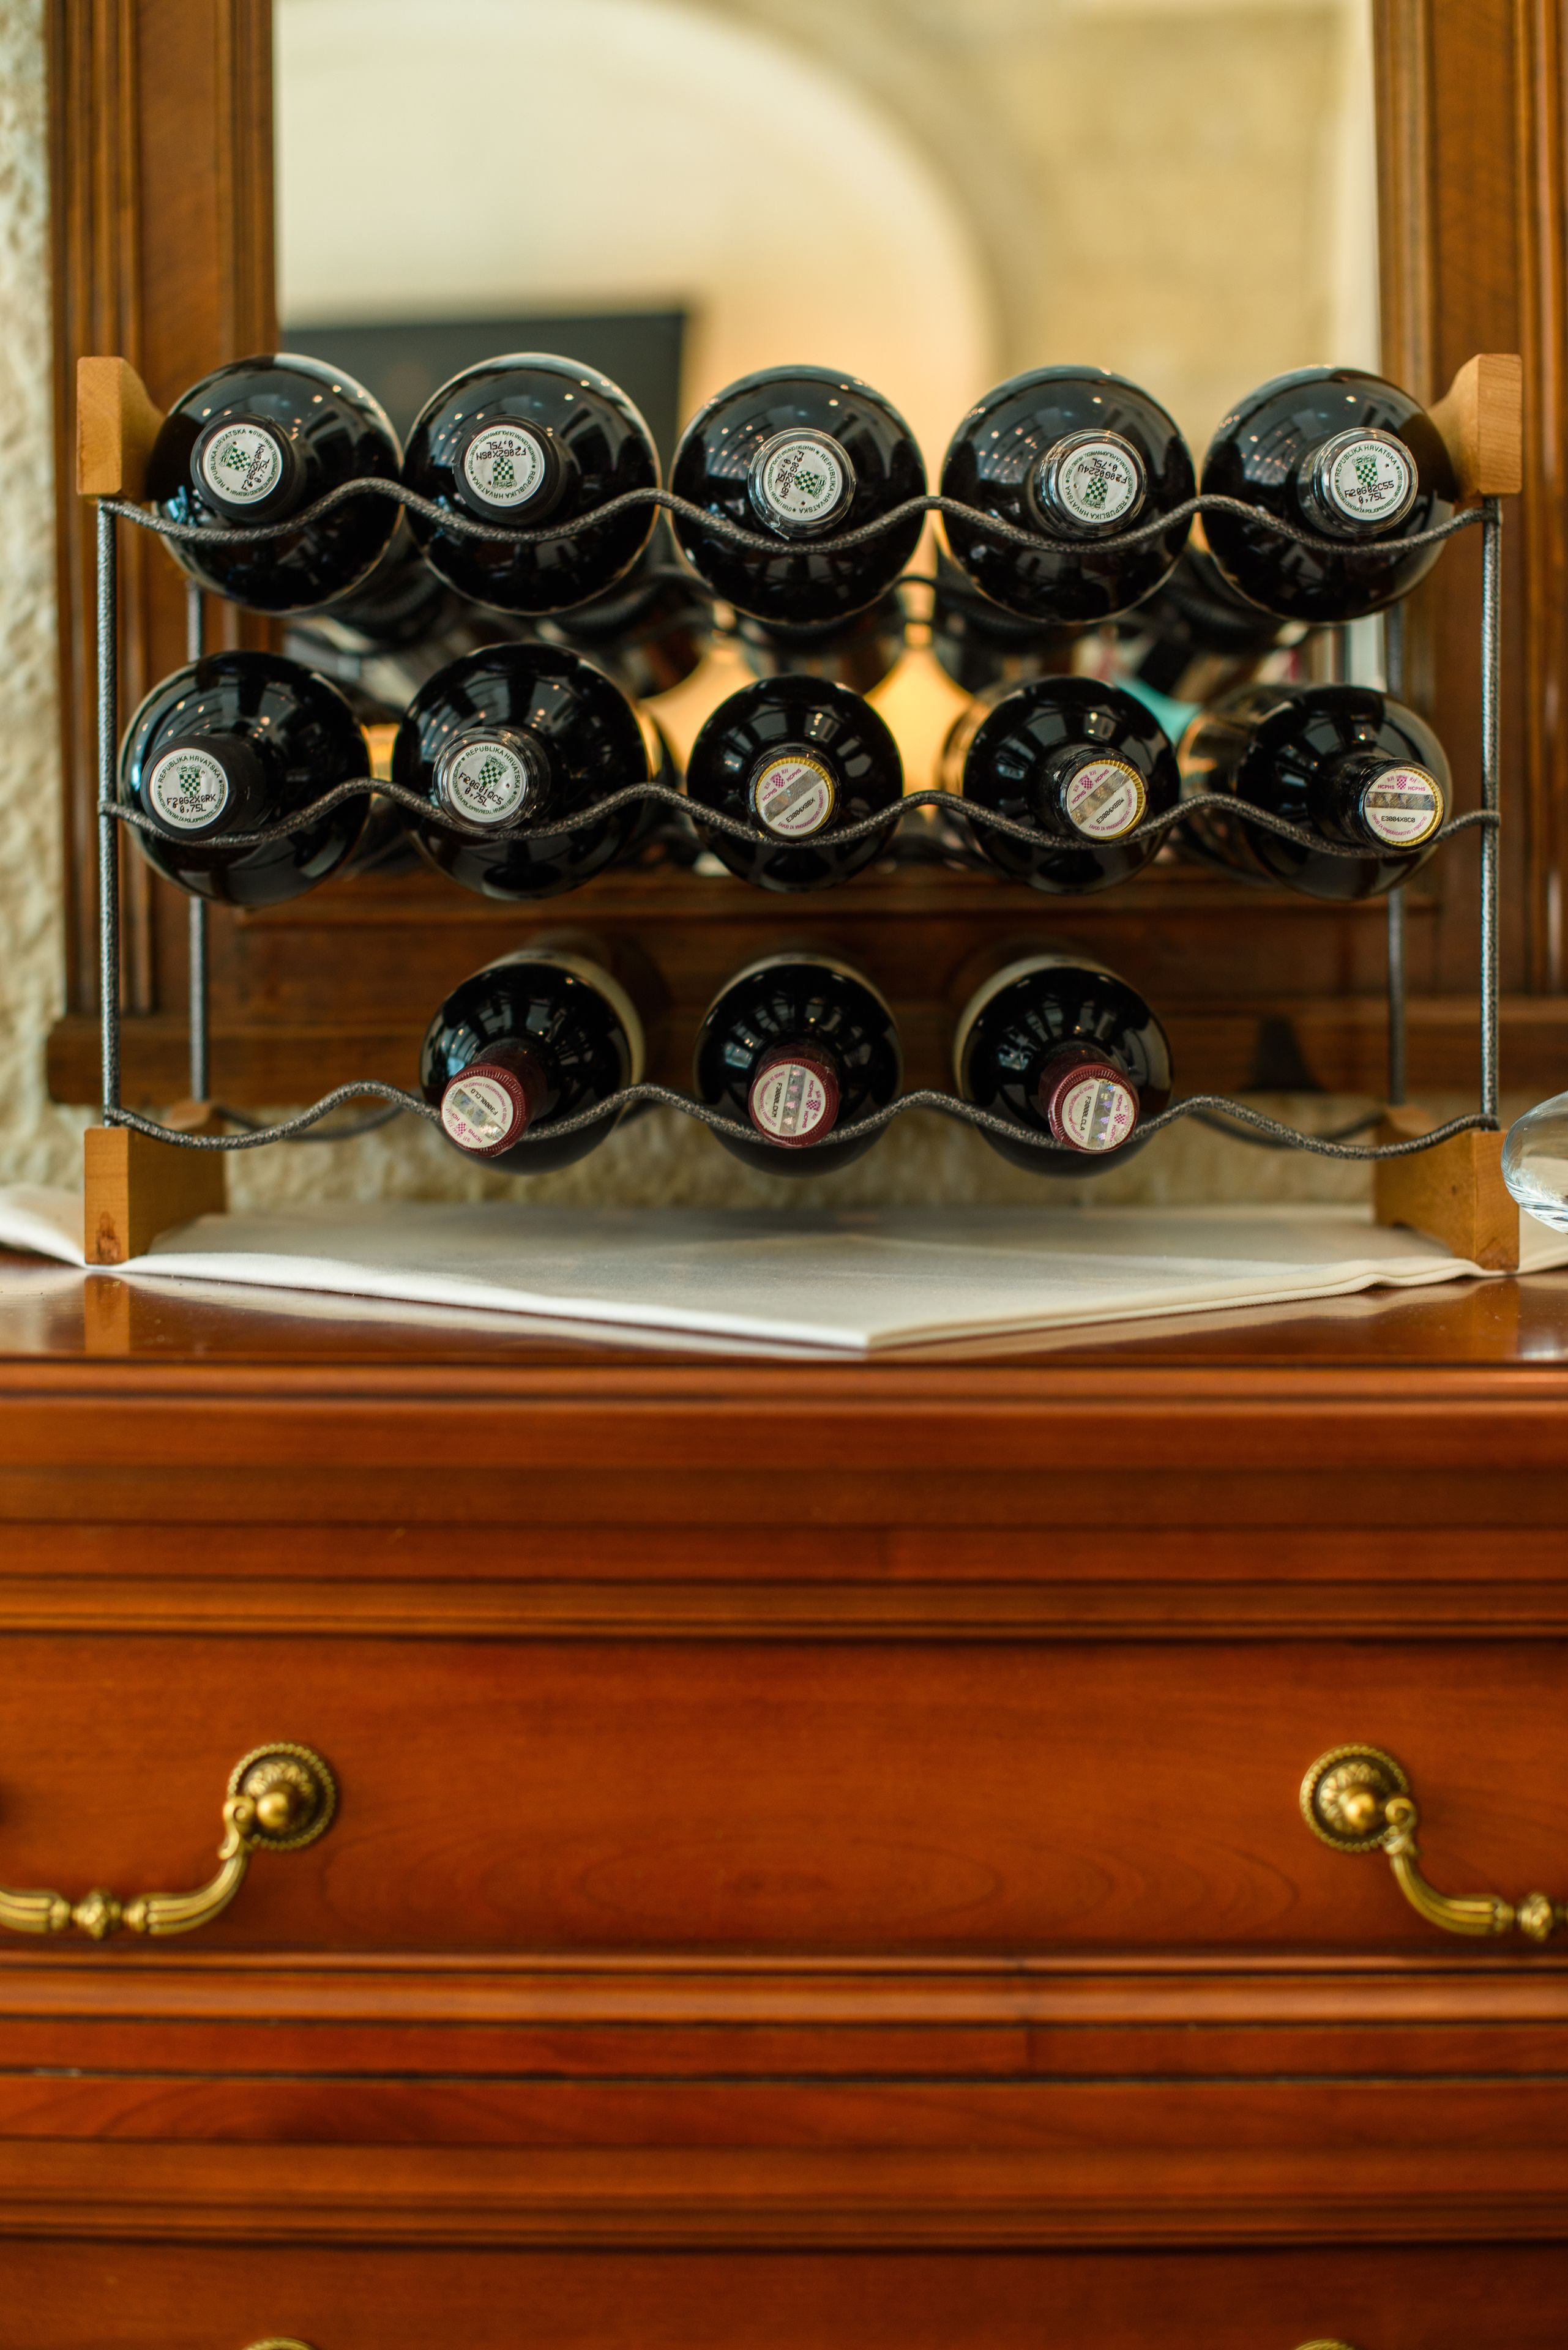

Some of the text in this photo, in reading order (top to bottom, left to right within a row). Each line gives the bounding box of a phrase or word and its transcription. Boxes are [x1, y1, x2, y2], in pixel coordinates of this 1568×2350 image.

[487, 440, 513, 450] 0,75L
[514, 433, 529, 445] CENTAR
[211, 428, 245, 488] REPUBLIKA HRVATSKA
[254, 458, 270, 483] 0,75L
[775, 458, 791, 483] 0,75L
[1092, 458, 1118, 471] 0,75L
[1119, 460, 1131, 475] CENTAR
[1335, 446, 1398, 477] REPUBLIKA HRVATSKA
[471, 470, 536, 498] REPUBLIKA HRVATSKA
[799, 453, 835, 513] REPUBLIKA HRVATSKA
[771, 491, 782, 504] HRANU
[1065, 486, 1127, 518] REPUBLIKA HRVATSKA
[1344, 501, 1359, 512] CENTAR
[1359, 492, 1386, 504] 0,75L
[158, 755, 222, 783] REPUBLIKA HRVATSKA
[465, 746, 521, 789] REPUBLIKA HRVATSKA
[465, 788, 487, 807] 0,75L
[762, 769, 802, 801] HCPHS HCPHS
[1071, 769, 1110, 804] HCPHS HCPHS
[164, 807, 179, 819] CENTAR
[180, 804, 206, 813] 0,75L
[1381, 826, 1411, 836] VINOGRADARSTVO
[446, 1108, 483, 1143] HCPHS HCP
